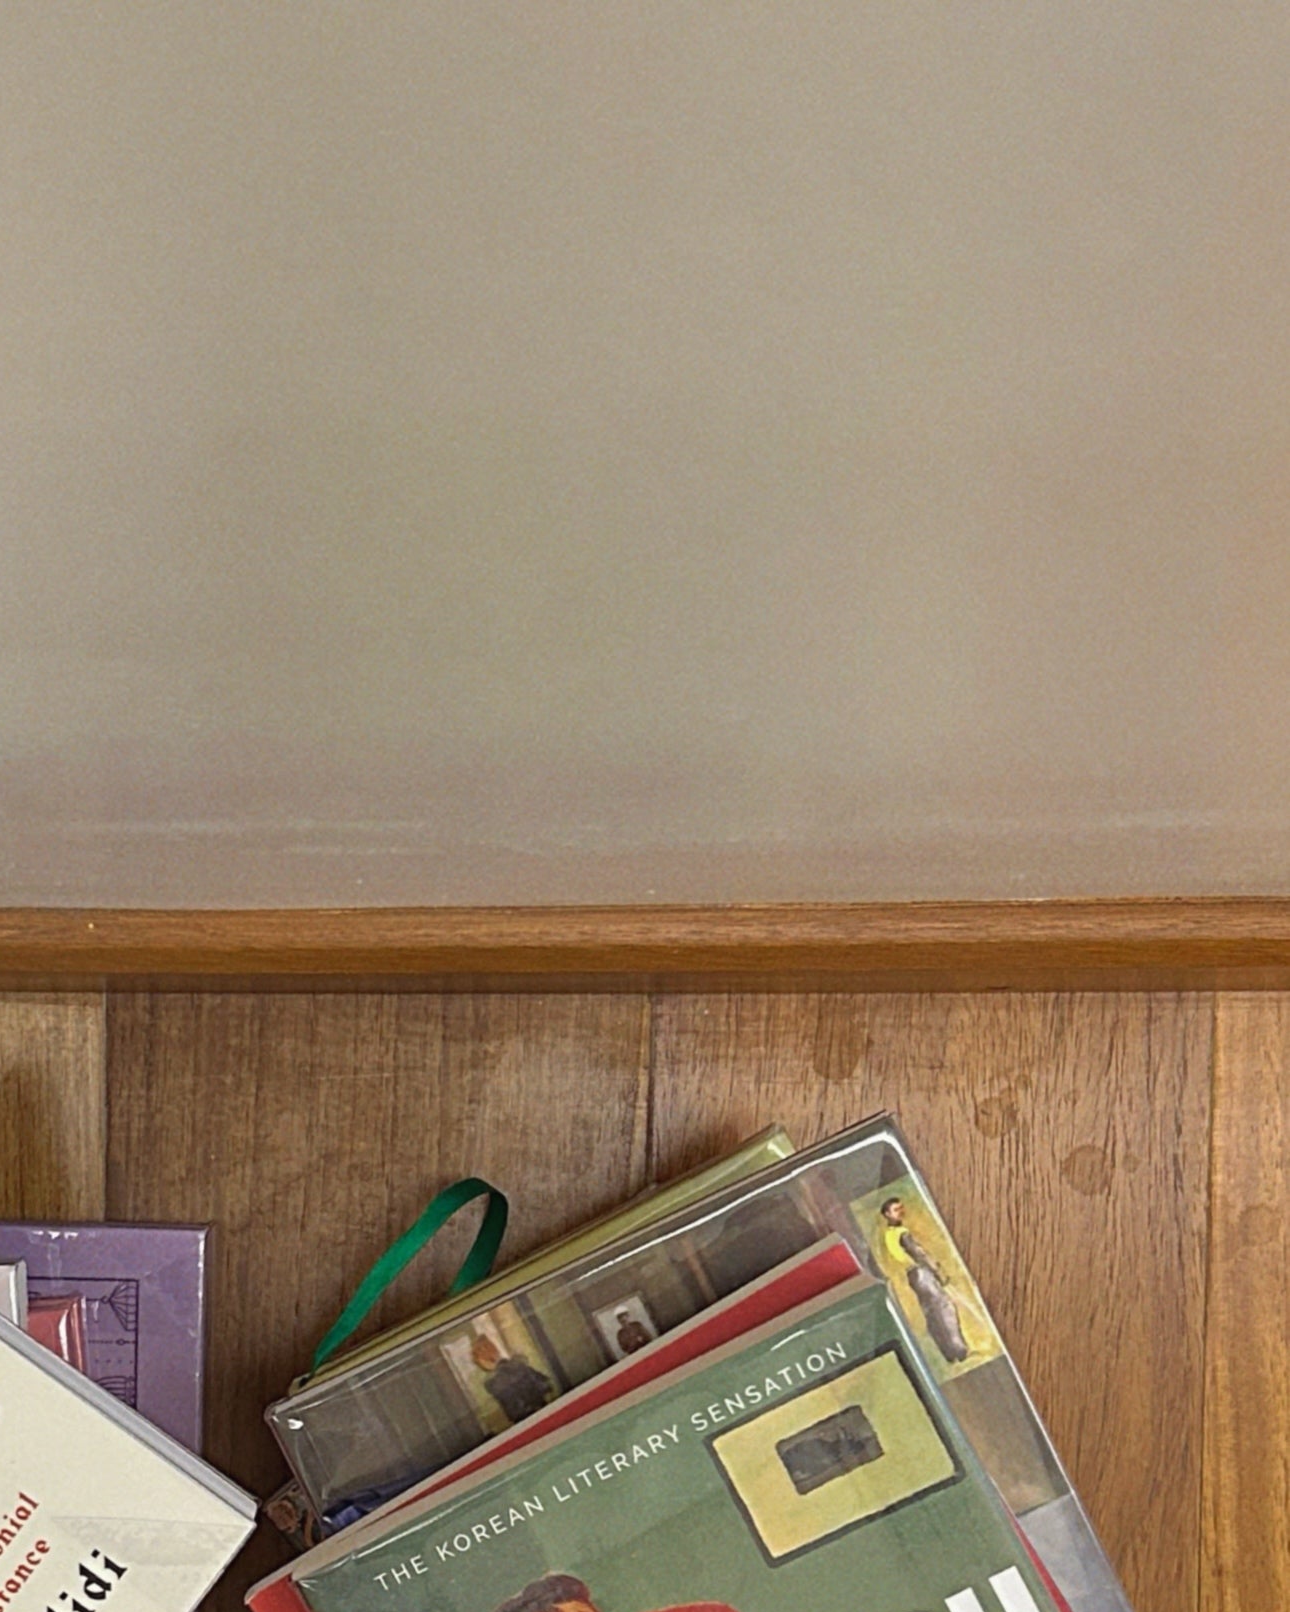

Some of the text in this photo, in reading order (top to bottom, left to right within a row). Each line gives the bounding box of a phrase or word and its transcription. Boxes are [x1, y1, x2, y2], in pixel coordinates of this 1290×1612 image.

[373, 1341, 849, 1592] THE KOREAN LITERARY SENSATION
